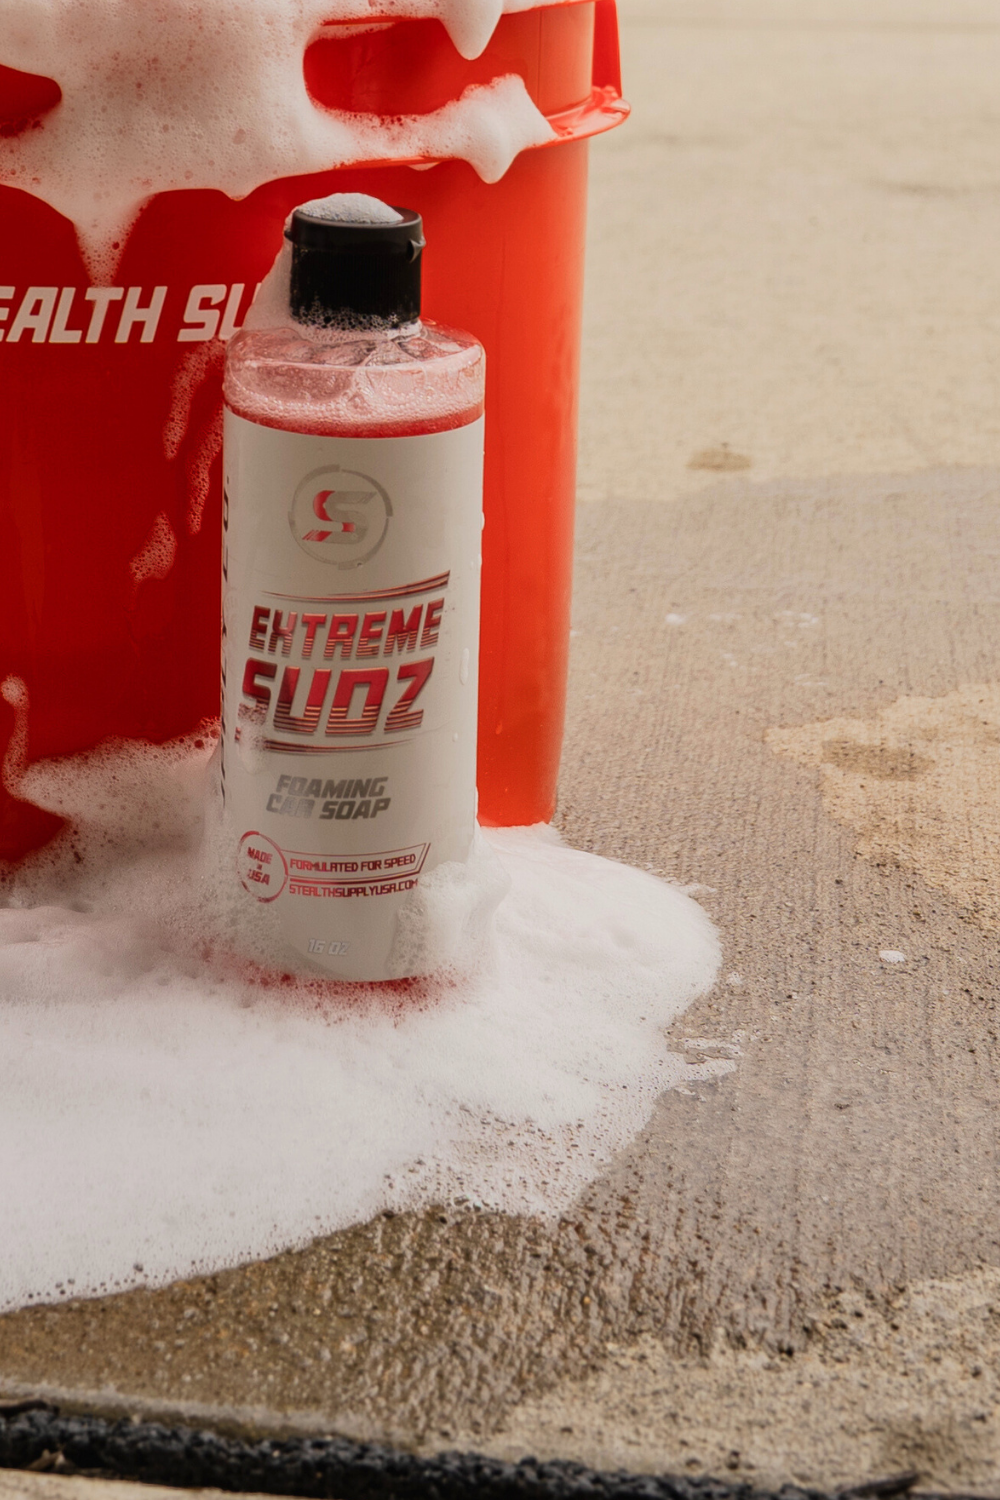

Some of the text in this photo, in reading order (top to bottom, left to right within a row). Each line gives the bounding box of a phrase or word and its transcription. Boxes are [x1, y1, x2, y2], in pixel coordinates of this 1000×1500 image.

[249, 598, 445, 658] EXTREME
[237, 657, 434, 736] SUDZ
[276, 774, 388, 799] FOAMING
[266, 793, 391, 820] CAR SOAP
[247, 847, 273, 864] MADE
[290, 854, 416, 872] FORMULATED FOR SPEED
[247, 868, 270, 886] USA
[289, 879, 418, 898] STEALTHSUPPLYUSA.COM
[308, 939, 325, 954] 16
